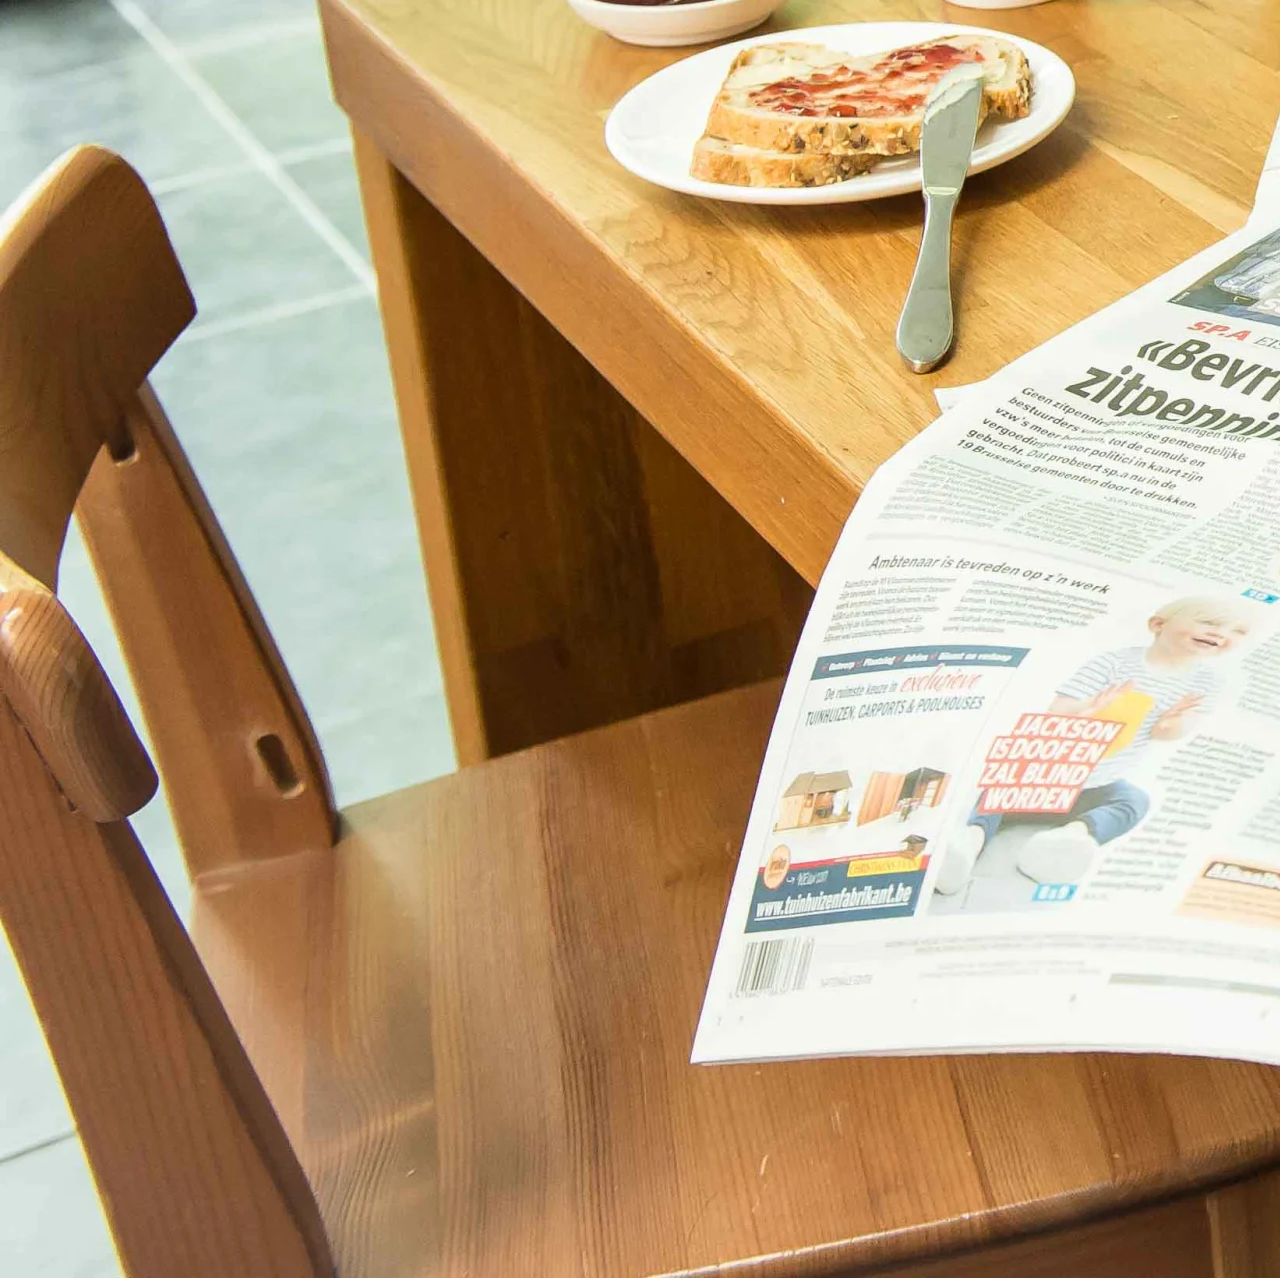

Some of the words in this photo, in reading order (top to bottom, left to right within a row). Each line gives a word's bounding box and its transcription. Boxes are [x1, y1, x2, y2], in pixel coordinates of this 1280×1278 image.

[1186, 320, 1252, 342] SP.A
[1021, 386, 1053, 405] Geen
[1007, 396, 1081, 433] bestuurders
[1161, 435, 1247, 462] gemeentelijke
[965, 428, 1025, 457] gebracht.
[1045, 452, 1103, 478] probeert
[982, 417, 1062, 450] vergoedingen
[1062, 441, 1093, 455] voor
[1091, 447, 1137, 467] politici
[1147, 460, 1182, 478] kaart
[1181, 469, 1205, 483] zijn
[1029, 423, 1063, 441] meer
[1144, 446, 1189, 463] cumuls
[1189, 458, 1206, 469] en
[956, 438, 973, 452] 19
[972, 443, 1032, 472] Brusselse
[1031, 462, 1100, 487] gemeenten
[1099, 481, 1130, 495] door
[1143, 490, 1198, 510] drukken.
[869, 554, 943, 572] Ambtenaar
[941, 558, 955, 569] is
[954, 558, 1021, 578] tevreden
[1021, 568, 1043, 582] op
[1070, 577, 1113, 596] werk
[823, 687, 836, 702] De
[857, 699, 905, 718] CARPORTS
[917, 695, 986, 714] POOLHOUSES
[1010, 715, 1123, 741] JACKSON
[988, 737, 1014, 757] IS
[1012, 739, 1068, 761] DOOF
[1068, 742, 1106, 762] EN
[980, 761, 1020, 785] ZAL
[1019, 761, 1088, 786] BLIND
[981, 788, 1079, 812] WORDEN
[755, 882, 913, 918] www.tuinhuizenfabrikant.be
